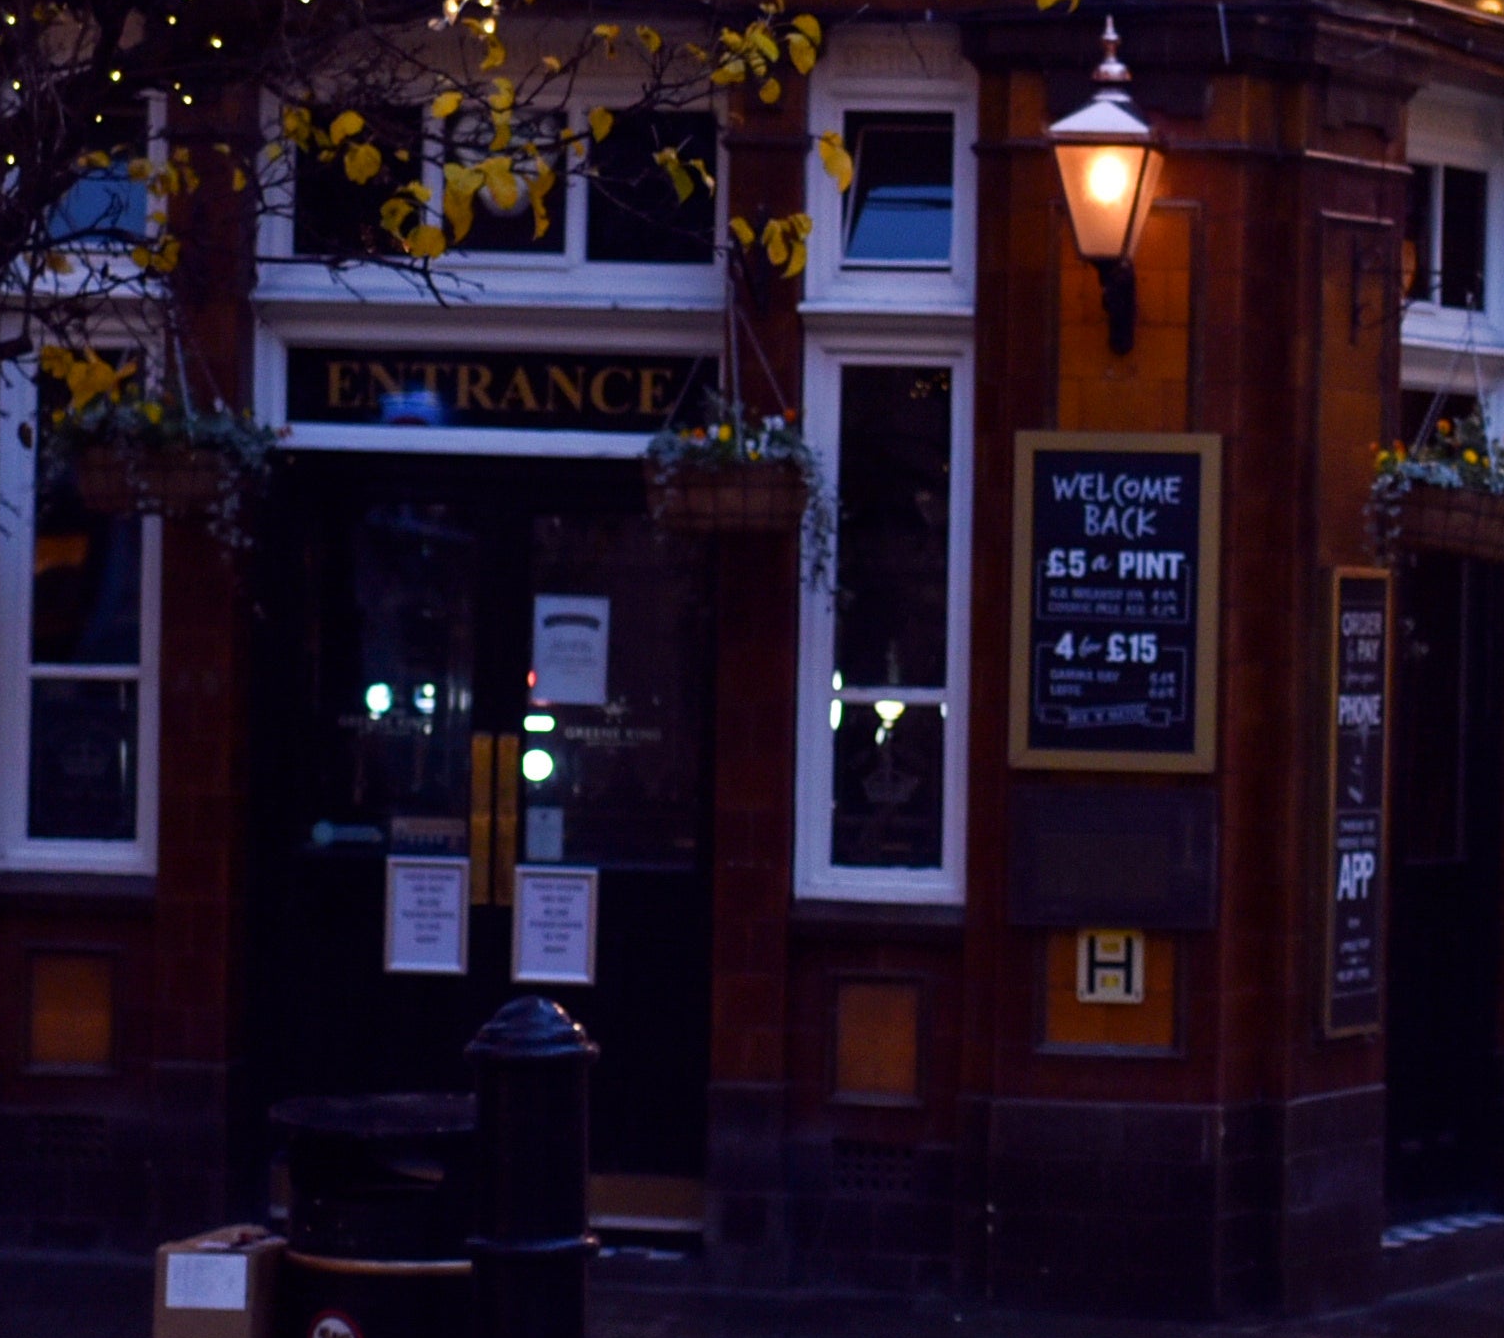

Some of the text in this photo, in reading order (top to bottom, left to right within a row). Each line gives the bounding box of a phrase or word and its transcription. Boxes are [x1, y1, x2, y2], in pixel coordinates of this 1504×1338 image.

[325, 358, 675, 417] ENTRANCE
[1051, 471, 1183, 508] WELCOME
[1082, 503, 1158, 541] BACK
[1045, 545, 1088, 580] £5
[1117, 549, 1187, 581] PINT
[1053, 630, 1075, 662] 4
[1104, 630, 1160, 665] £15
[1338, 693, 1383, 727] PHONE
[1335, 852, 1376, 902] APP
[1087, 934, 1133, 994] H
